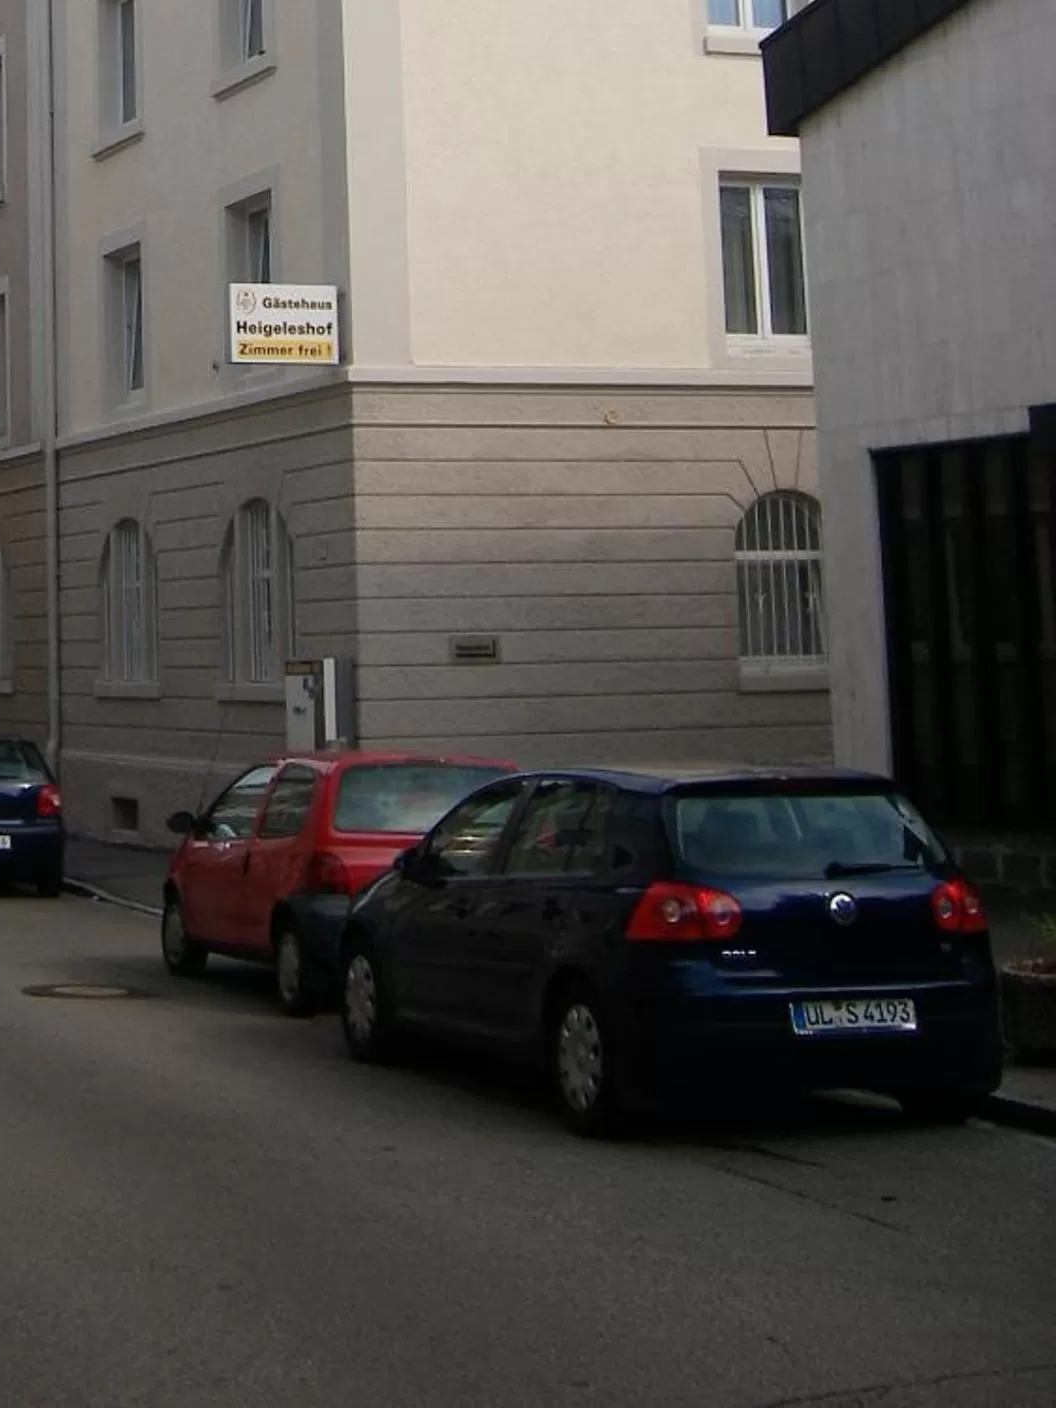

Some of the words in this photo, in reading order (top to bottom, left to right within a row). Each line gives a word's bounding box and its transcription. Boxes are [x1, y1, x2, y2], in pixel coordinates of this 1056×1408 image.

[262, 297, 333, 310] Gästehaus
[236, 320, 333, 337] Heigeleshof
[238, 343, 293, 356] Zimmer
[805, 1002, 833, 1025] UL
